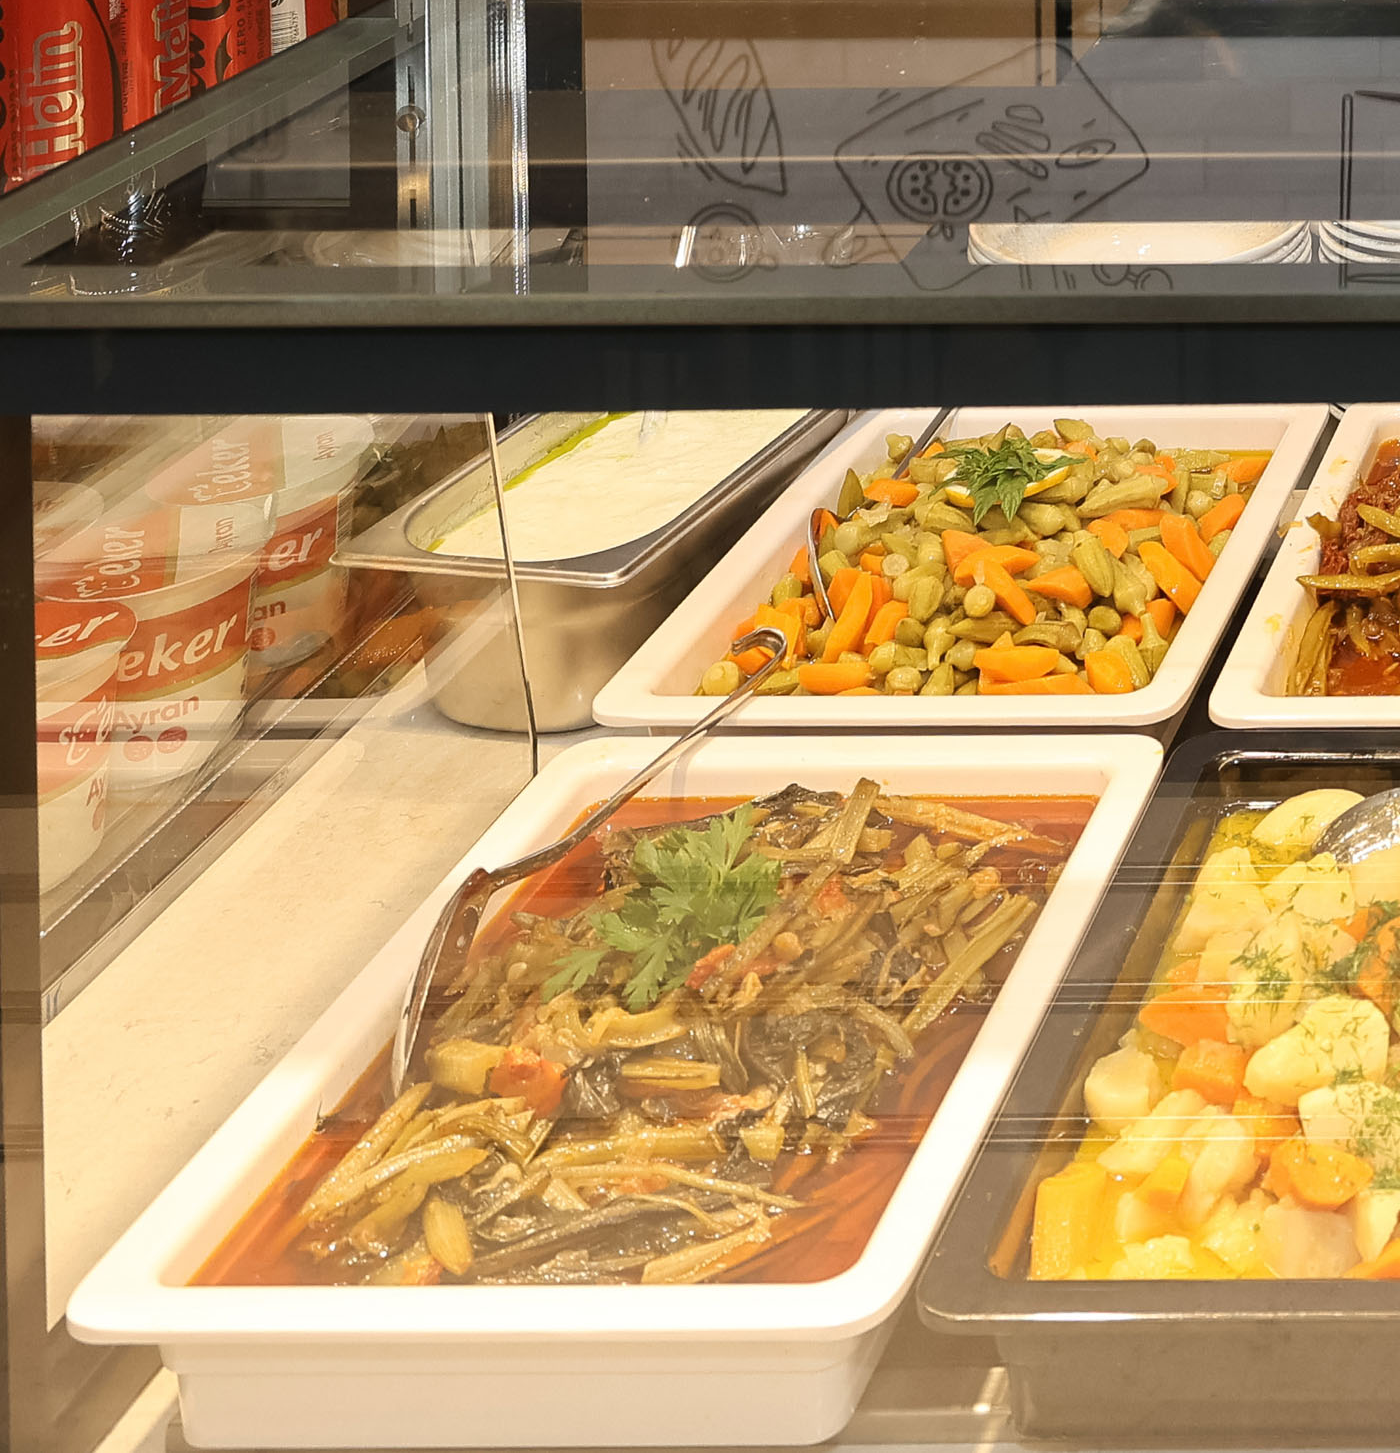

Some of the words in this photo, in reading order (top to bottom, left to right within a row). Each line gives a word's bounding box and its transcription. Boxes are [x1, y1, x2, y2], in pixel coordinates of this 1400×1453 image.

[236, 18, 247, 56] ZERO
[266, 527, 323, 572] er
[36, 611, 119, 648] er
